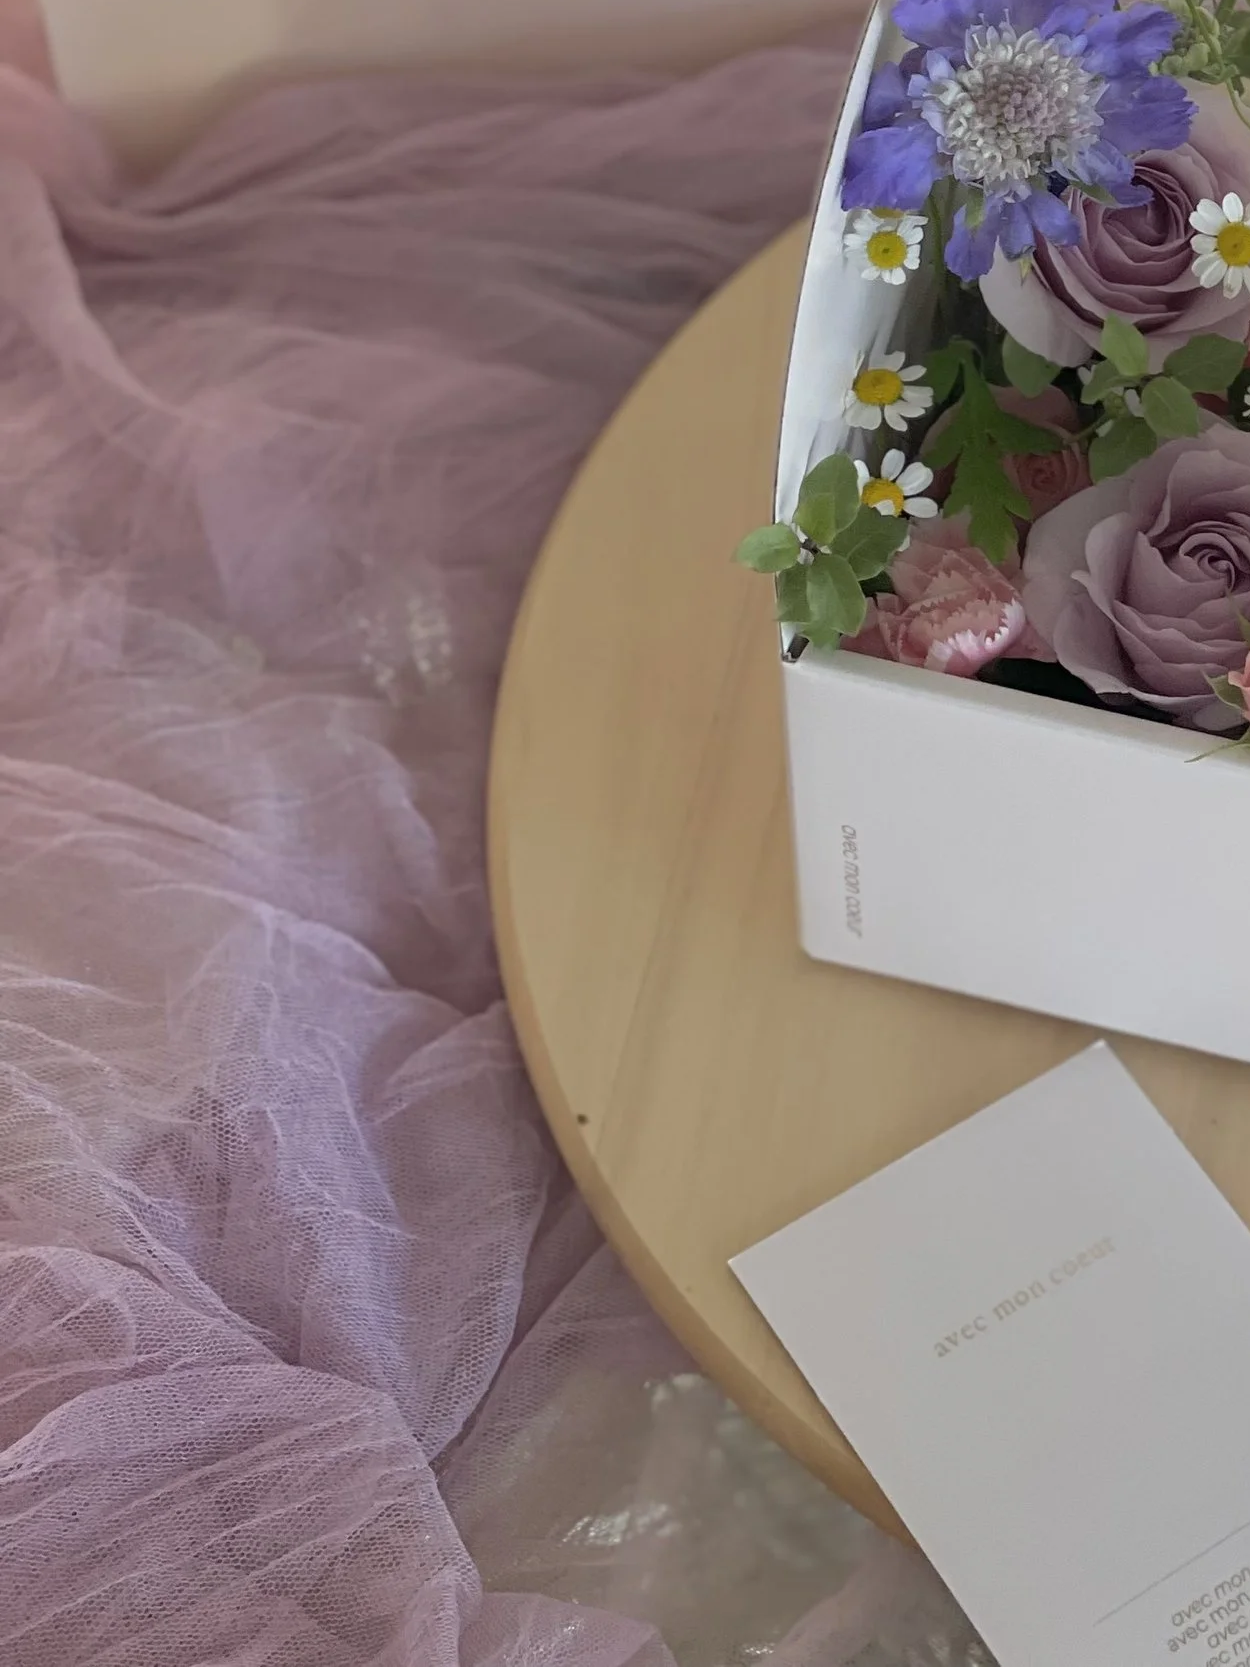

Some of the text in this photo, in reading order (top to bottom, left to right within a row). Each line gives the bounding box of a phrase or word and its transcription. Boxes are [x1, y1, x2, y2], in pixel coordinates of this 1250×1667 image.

[933, 1236, 1118, 1359] avec mon coeur
[1167, 1619, 1209, 1653] avec
[1209, 1591, 1250, 1625] mon
[1171, 1593, 1213, 1627] avec
[1207, 1615, 1249, 1649] avec
